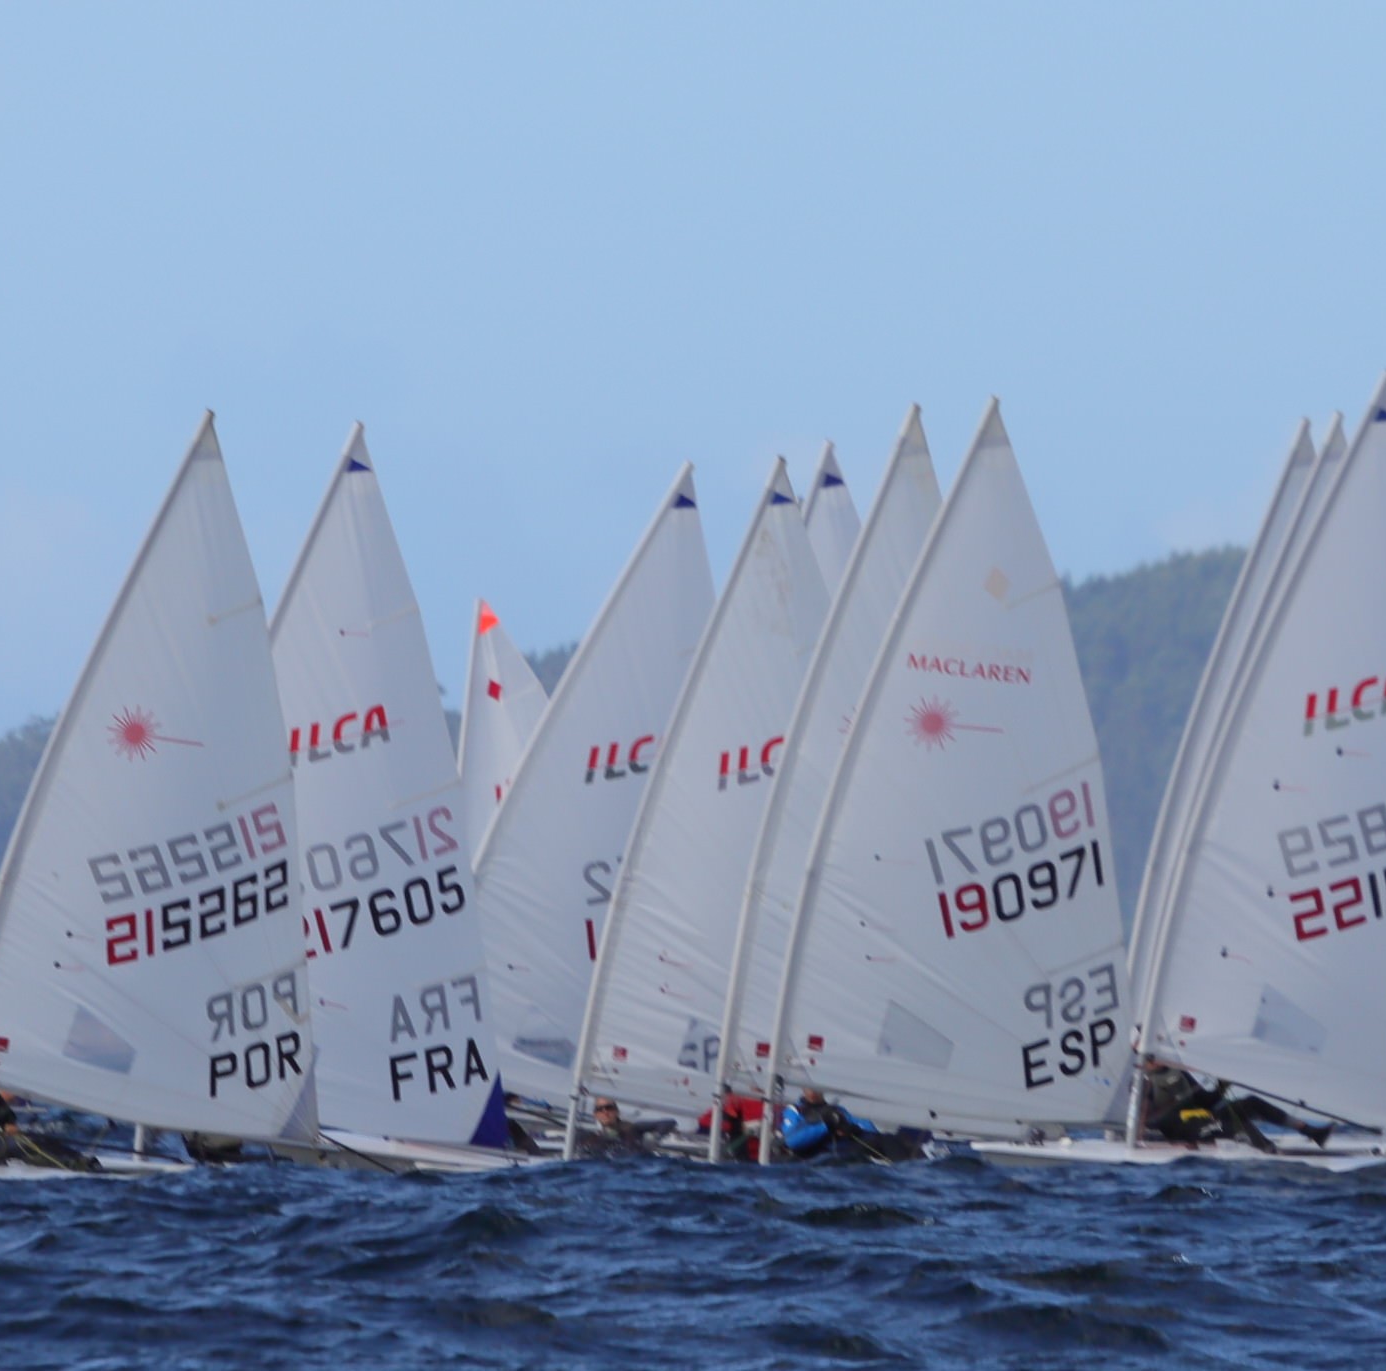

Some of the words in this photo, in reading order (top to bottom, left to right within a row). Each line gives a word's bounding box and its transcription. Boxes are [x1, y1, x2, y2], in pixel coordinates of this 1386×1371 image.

[907, 652, 1032, 685] MACLAREN
[288, 703, 391, 768] ILCA
[584, 734, 655, 786] ILC
[717, 734, 784, 793] ILC
[105, 858, 289, 968] 215262
[937, 838, 1105, 940] 190971
[209, 1030, 303, 1100] POR
[388, 1037, 490, 1103] FRA
[1022, 1018, 1116, 1090] ESP
